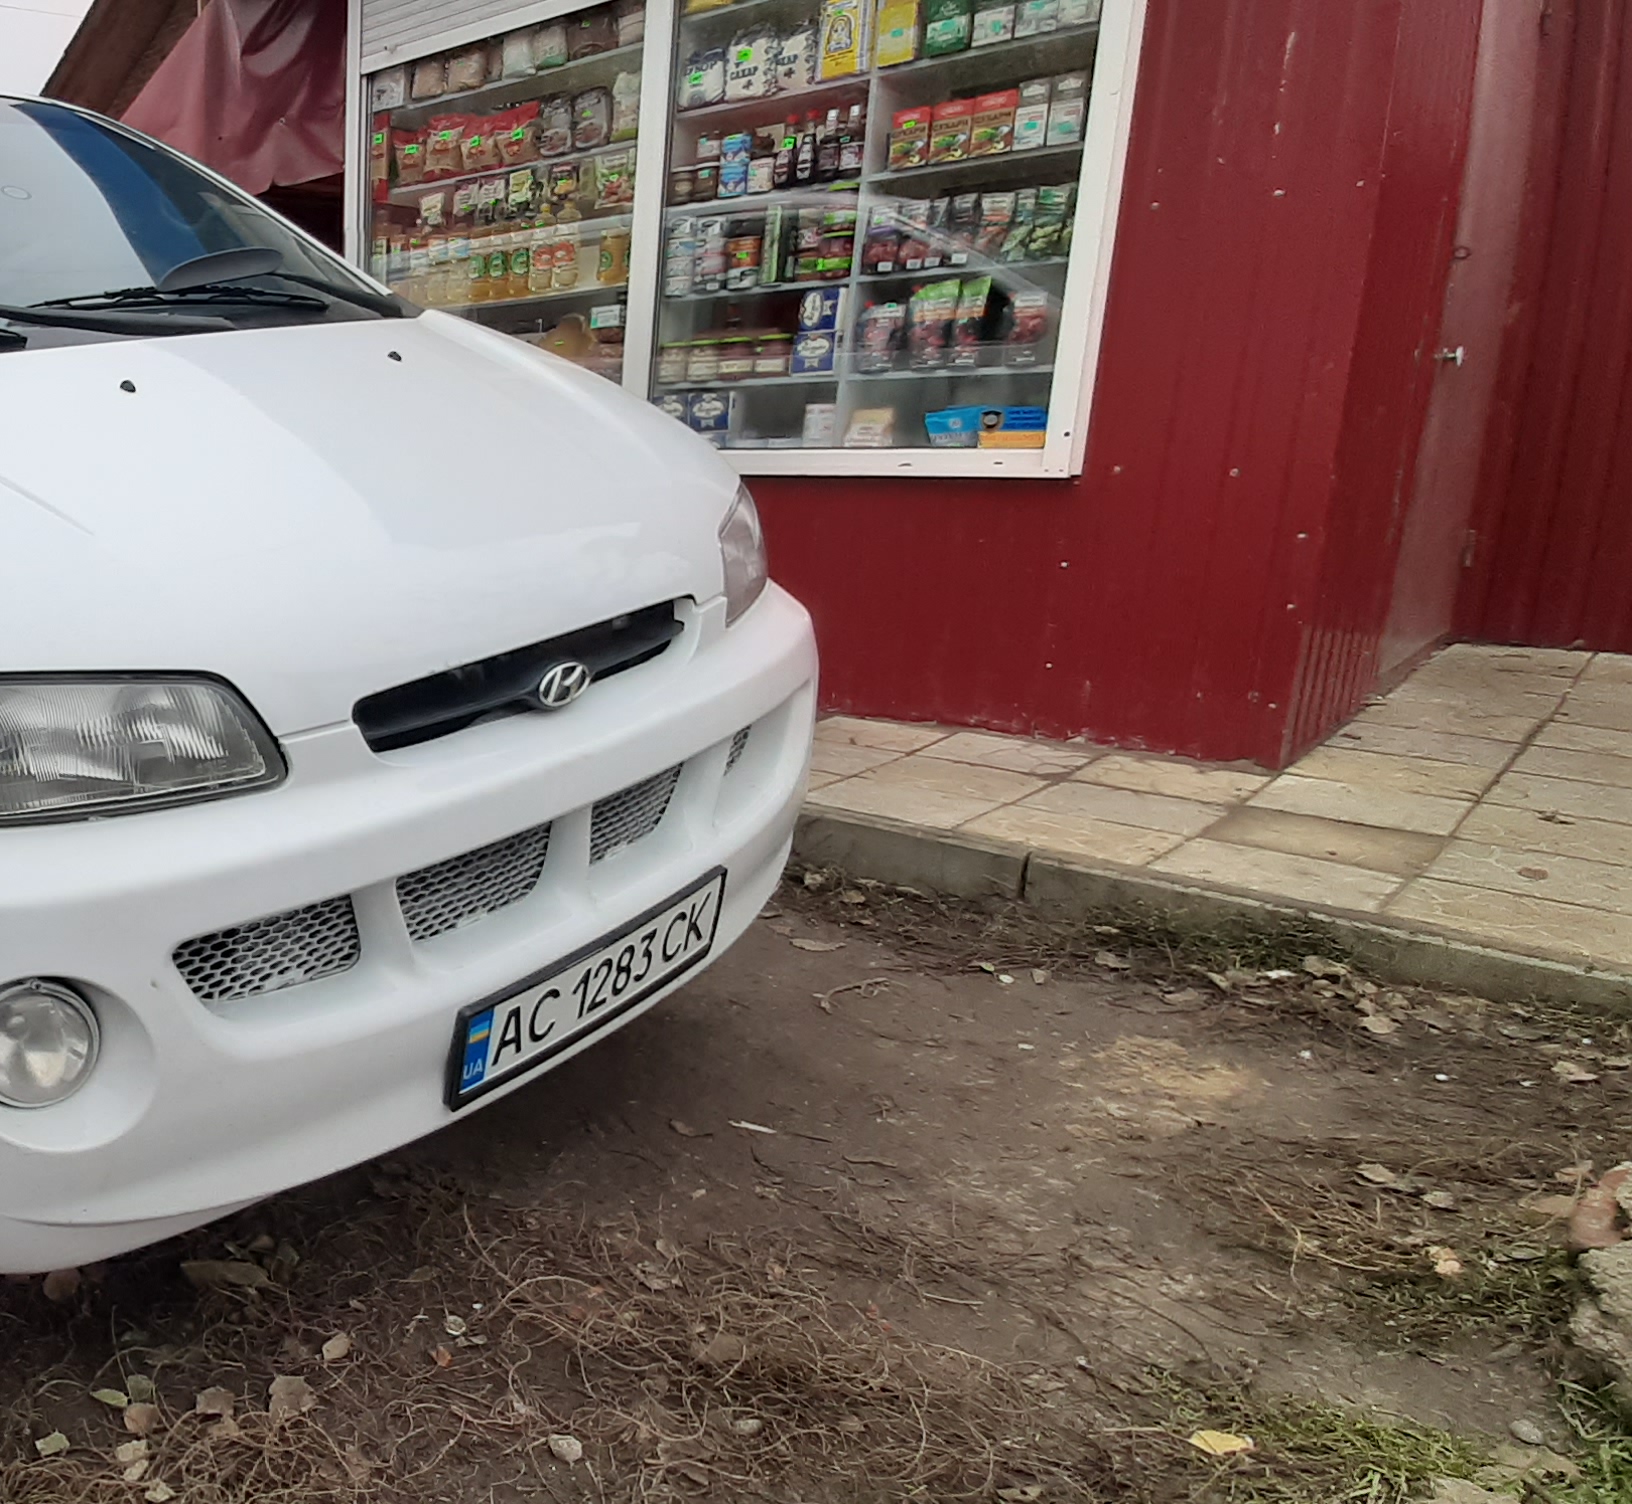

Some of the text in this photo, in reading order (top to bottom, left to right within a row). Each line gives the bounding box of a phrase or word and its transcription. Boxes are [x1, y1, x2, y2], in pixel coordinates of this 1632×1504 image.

[491, 891, 712, 1067] AC 1283 CK
[463, 1058, 483, 1081] UA
